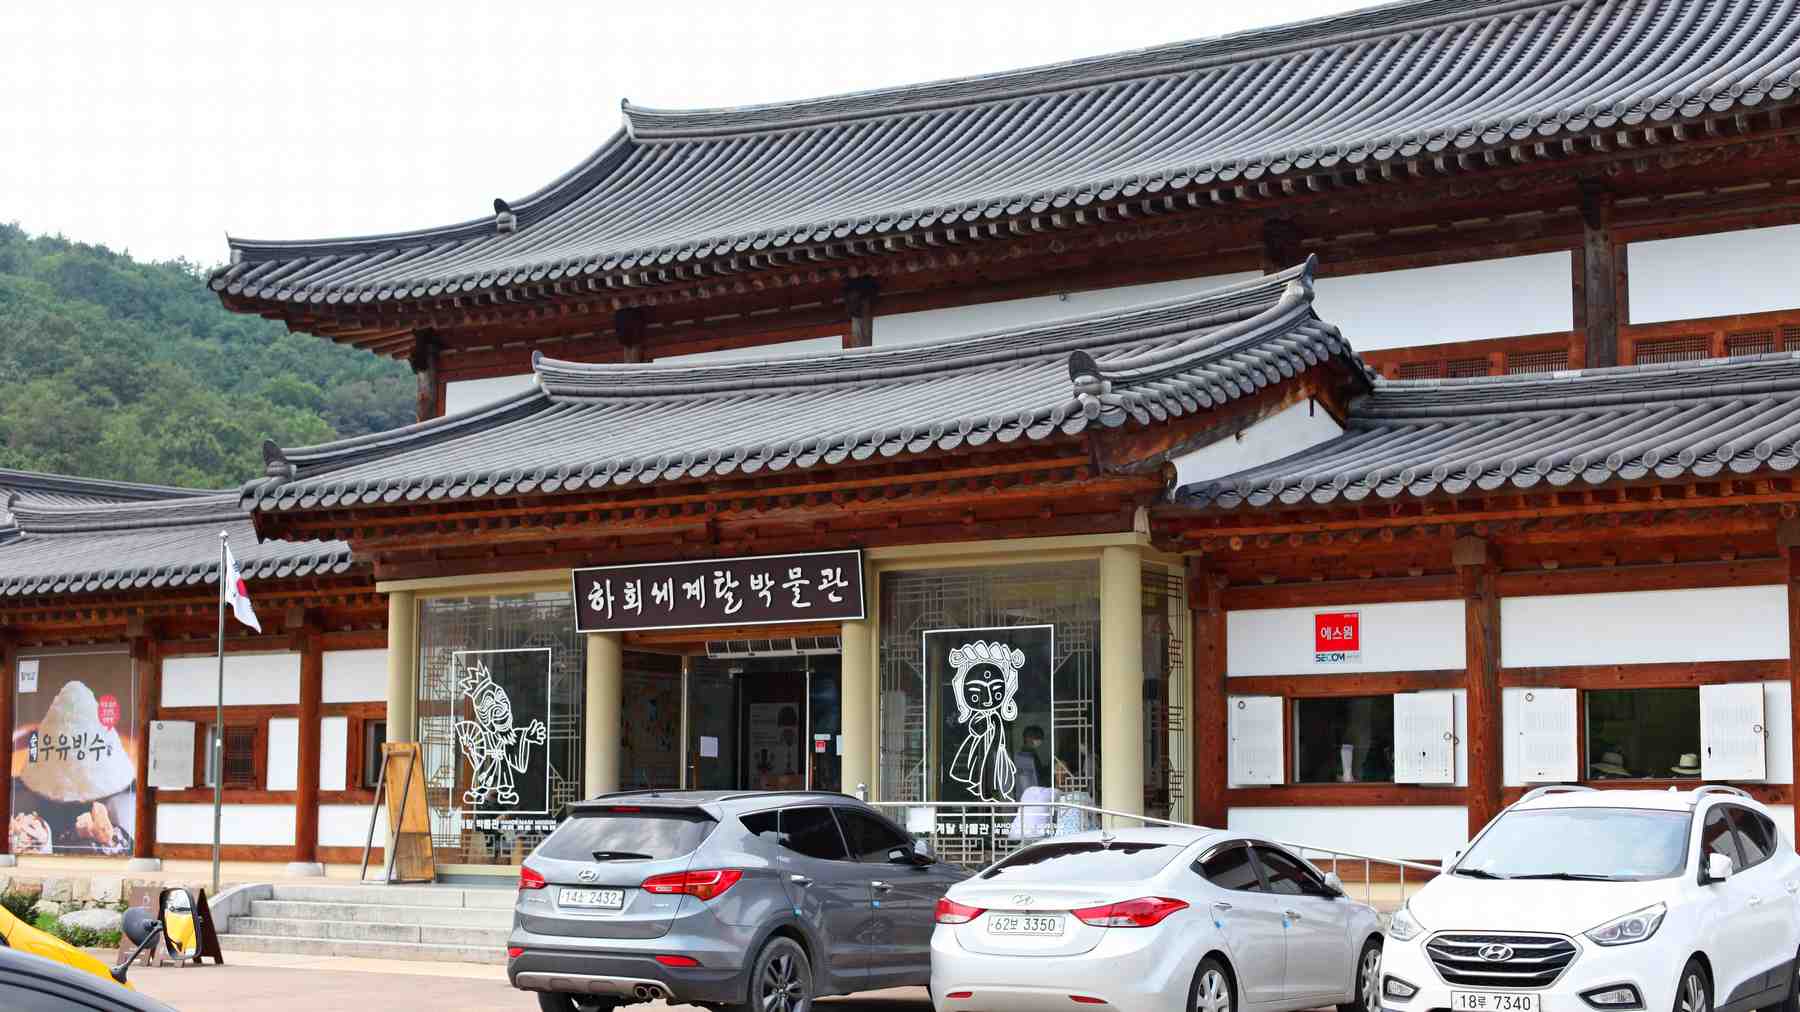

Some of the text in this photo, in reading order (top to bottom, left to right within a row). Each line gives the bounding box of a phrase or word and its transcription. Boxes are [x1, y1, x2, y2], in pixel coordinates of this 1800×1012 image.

[587, 567, 849, 619] 하회세계탈박물관
[1320, 625, 1353, 640] 에스원
[40, 732, 106, 762] 우유빙수
[589, 891, 617, 905] 2432
[1023, 917, 1056, 932] 3350
[1461, 994, 1531, 1011] 18루 7340
